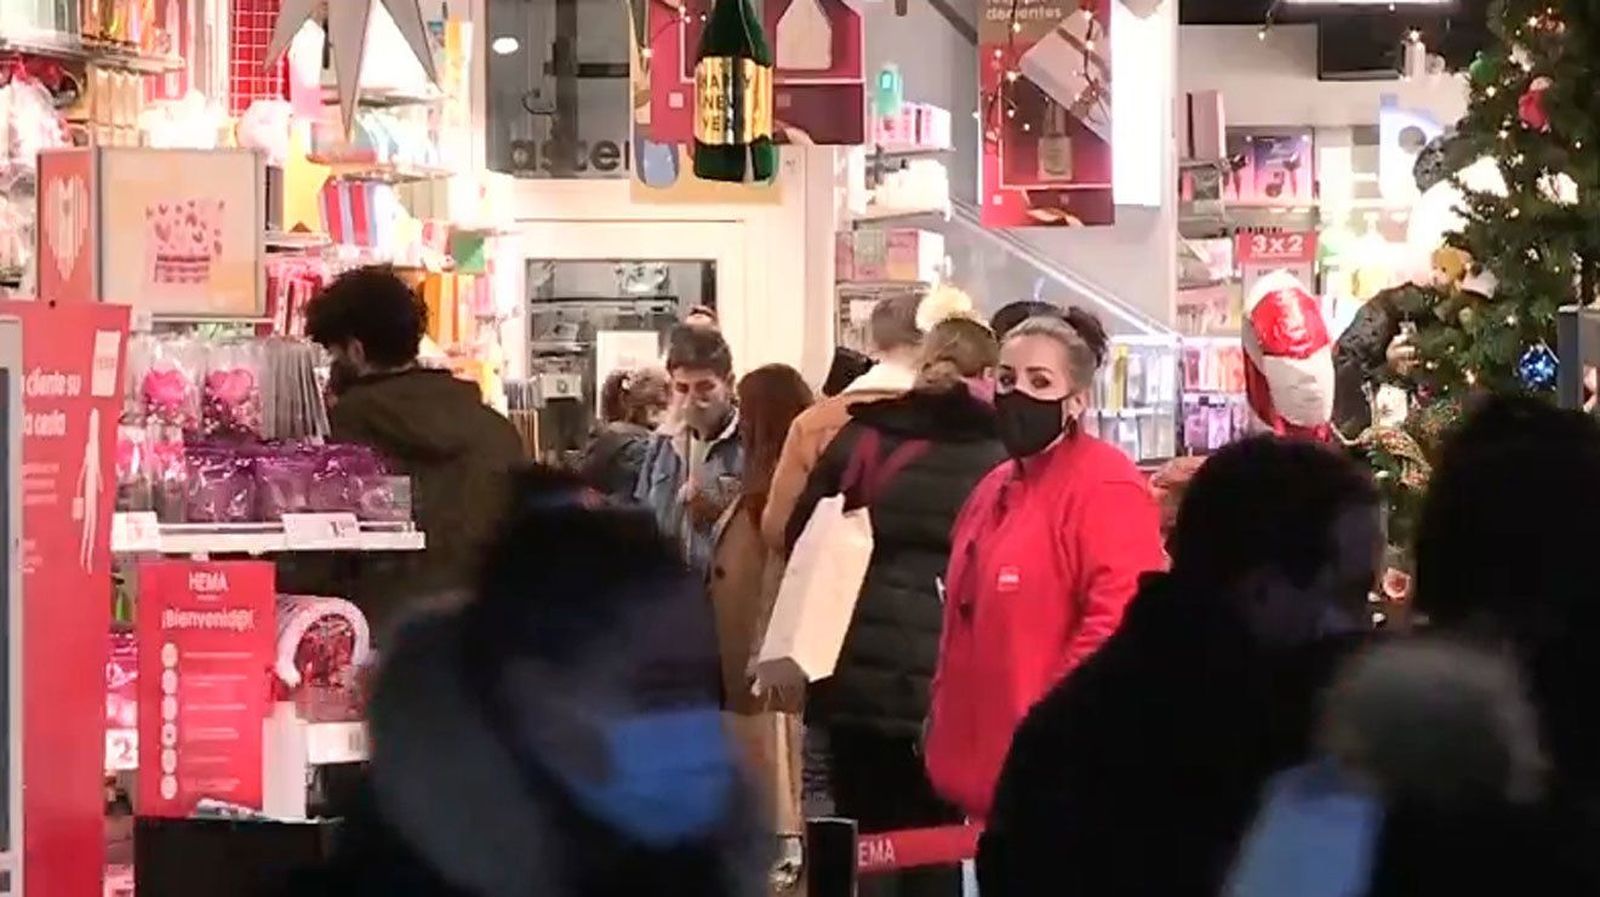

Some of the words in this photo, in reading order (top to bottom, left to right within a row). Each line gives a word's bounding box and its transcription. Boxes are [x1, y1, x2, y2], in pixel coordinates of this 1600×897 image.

[1250, 234, 1304, 253] 3x2
[188, 570, 230, 592] HEMA
[857, 838, 896, 868] EMA
